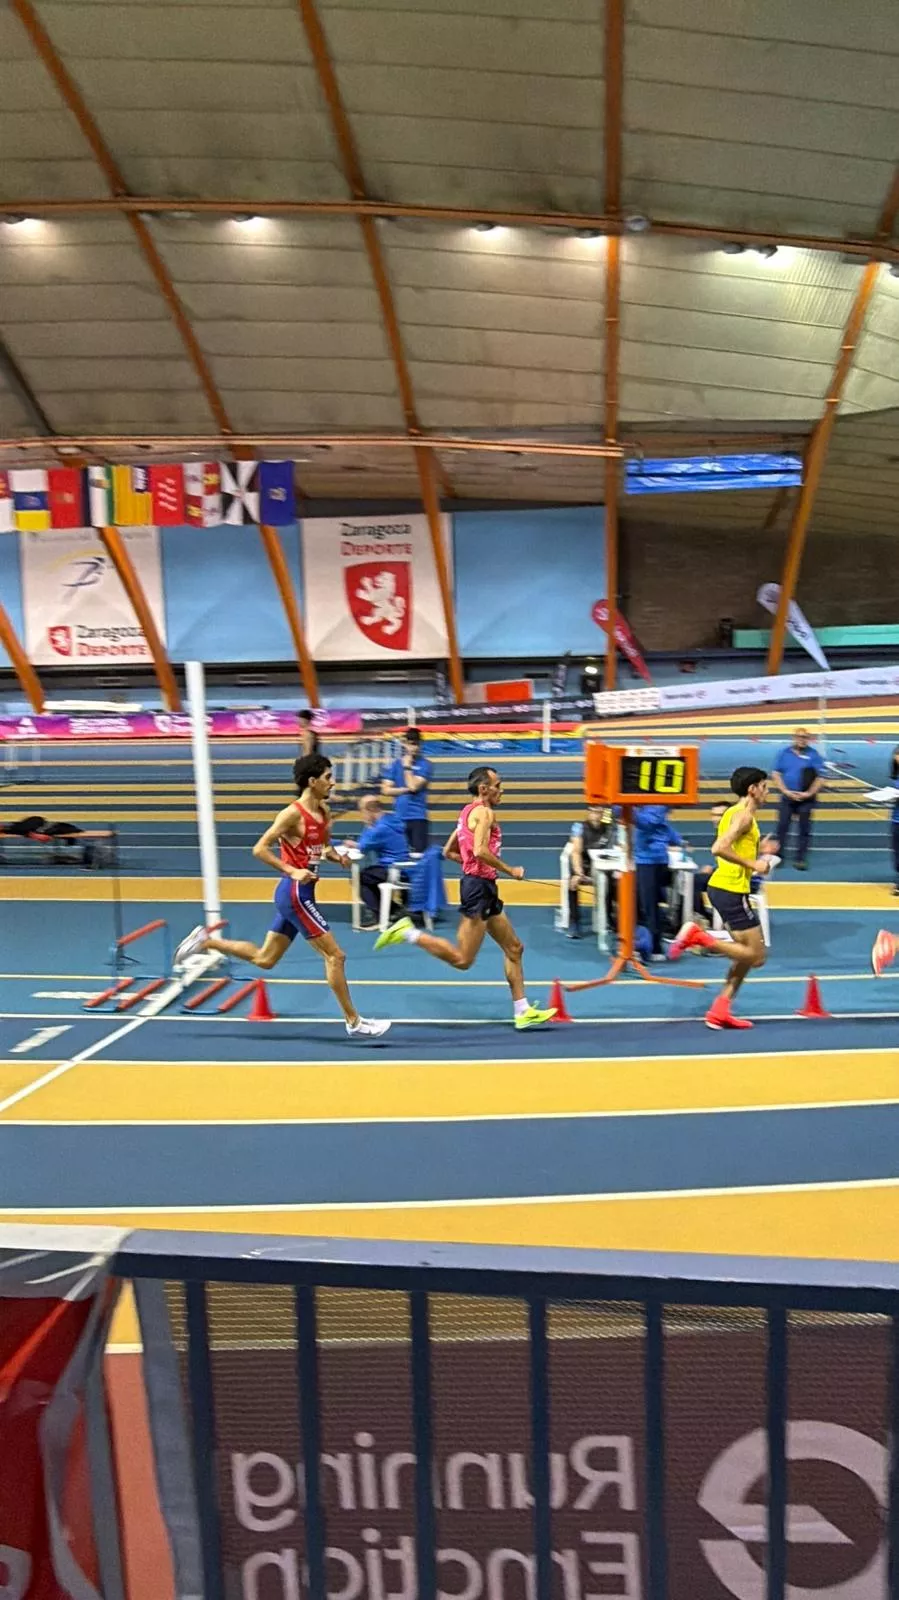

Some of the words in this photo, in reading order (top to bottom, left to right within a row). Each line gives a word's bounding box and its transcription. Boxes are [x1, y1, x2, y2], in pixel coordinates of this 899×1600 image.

[340, 522, 411, 539] Zaragoza
[75, 624, 144, 642] Zaragoza
[639, 760, 685, 793] 10
